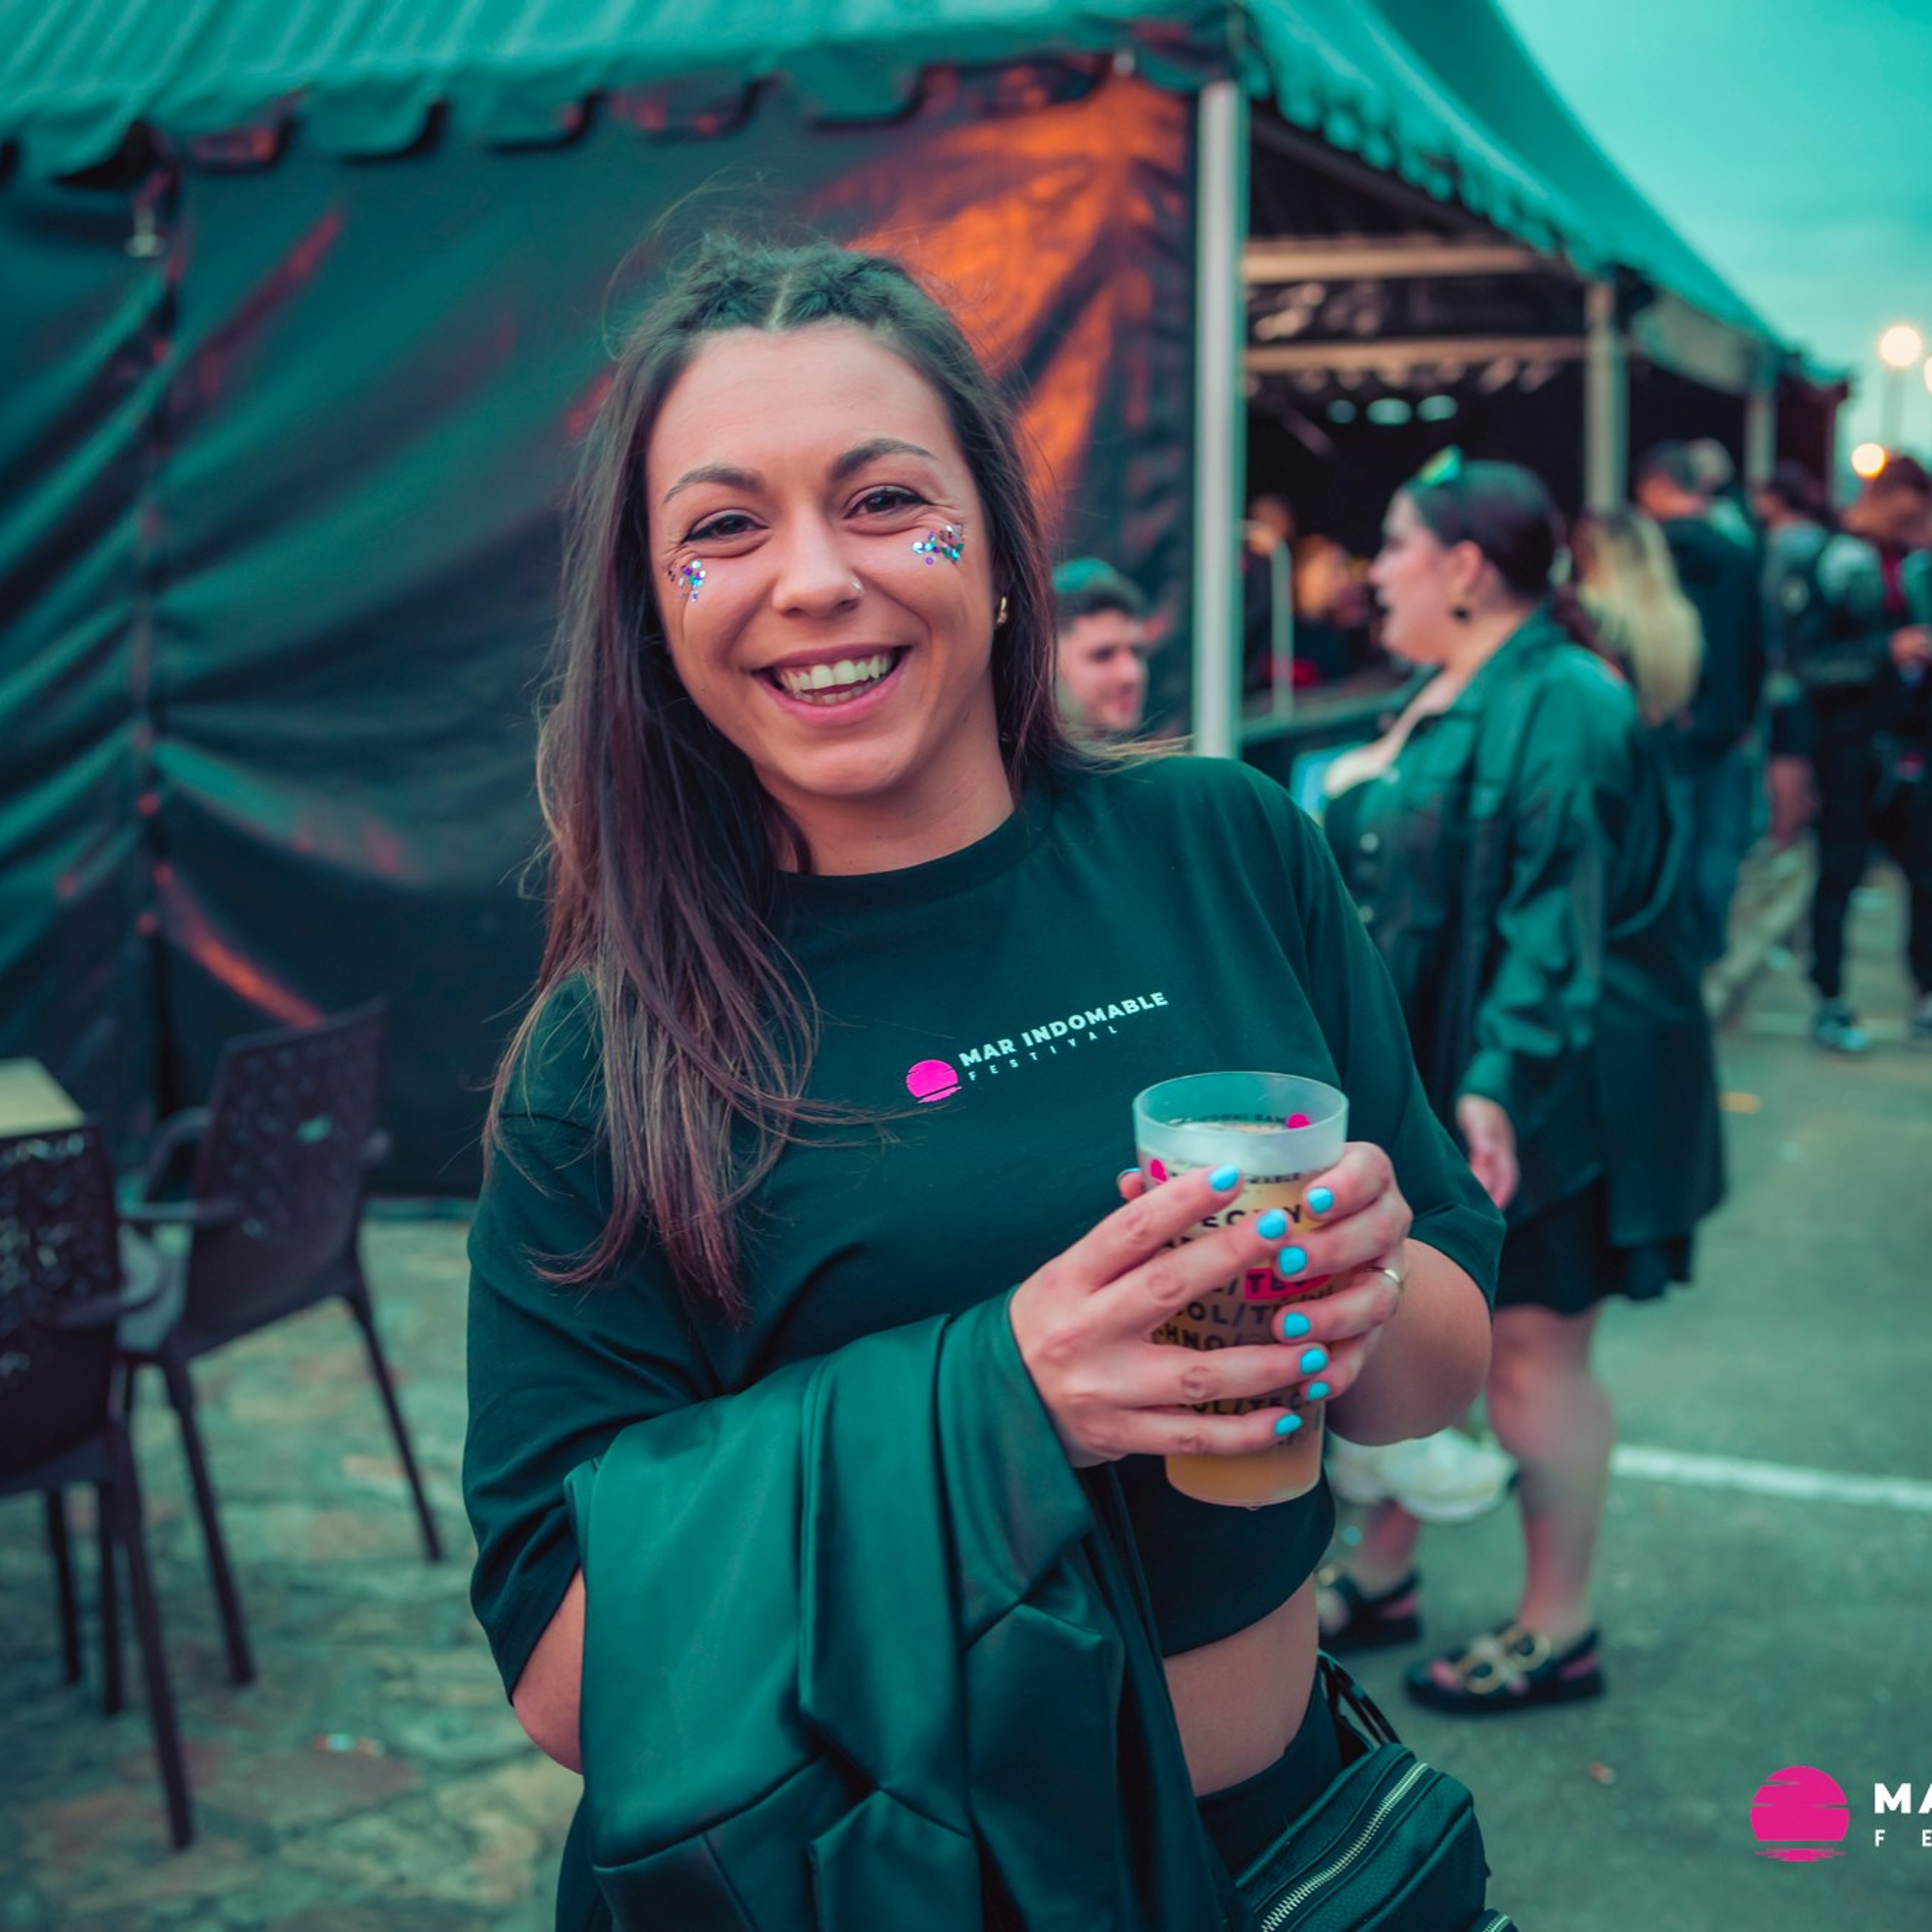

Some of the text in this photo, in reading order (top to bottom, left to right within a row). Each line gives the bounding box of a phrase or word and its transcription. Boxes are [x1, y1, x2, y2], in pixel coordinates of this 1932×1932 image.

[958, 991, 1168, 1067] MAR INDOMABLE
[968, 1026, 1117, 1081] FESTIVAL
